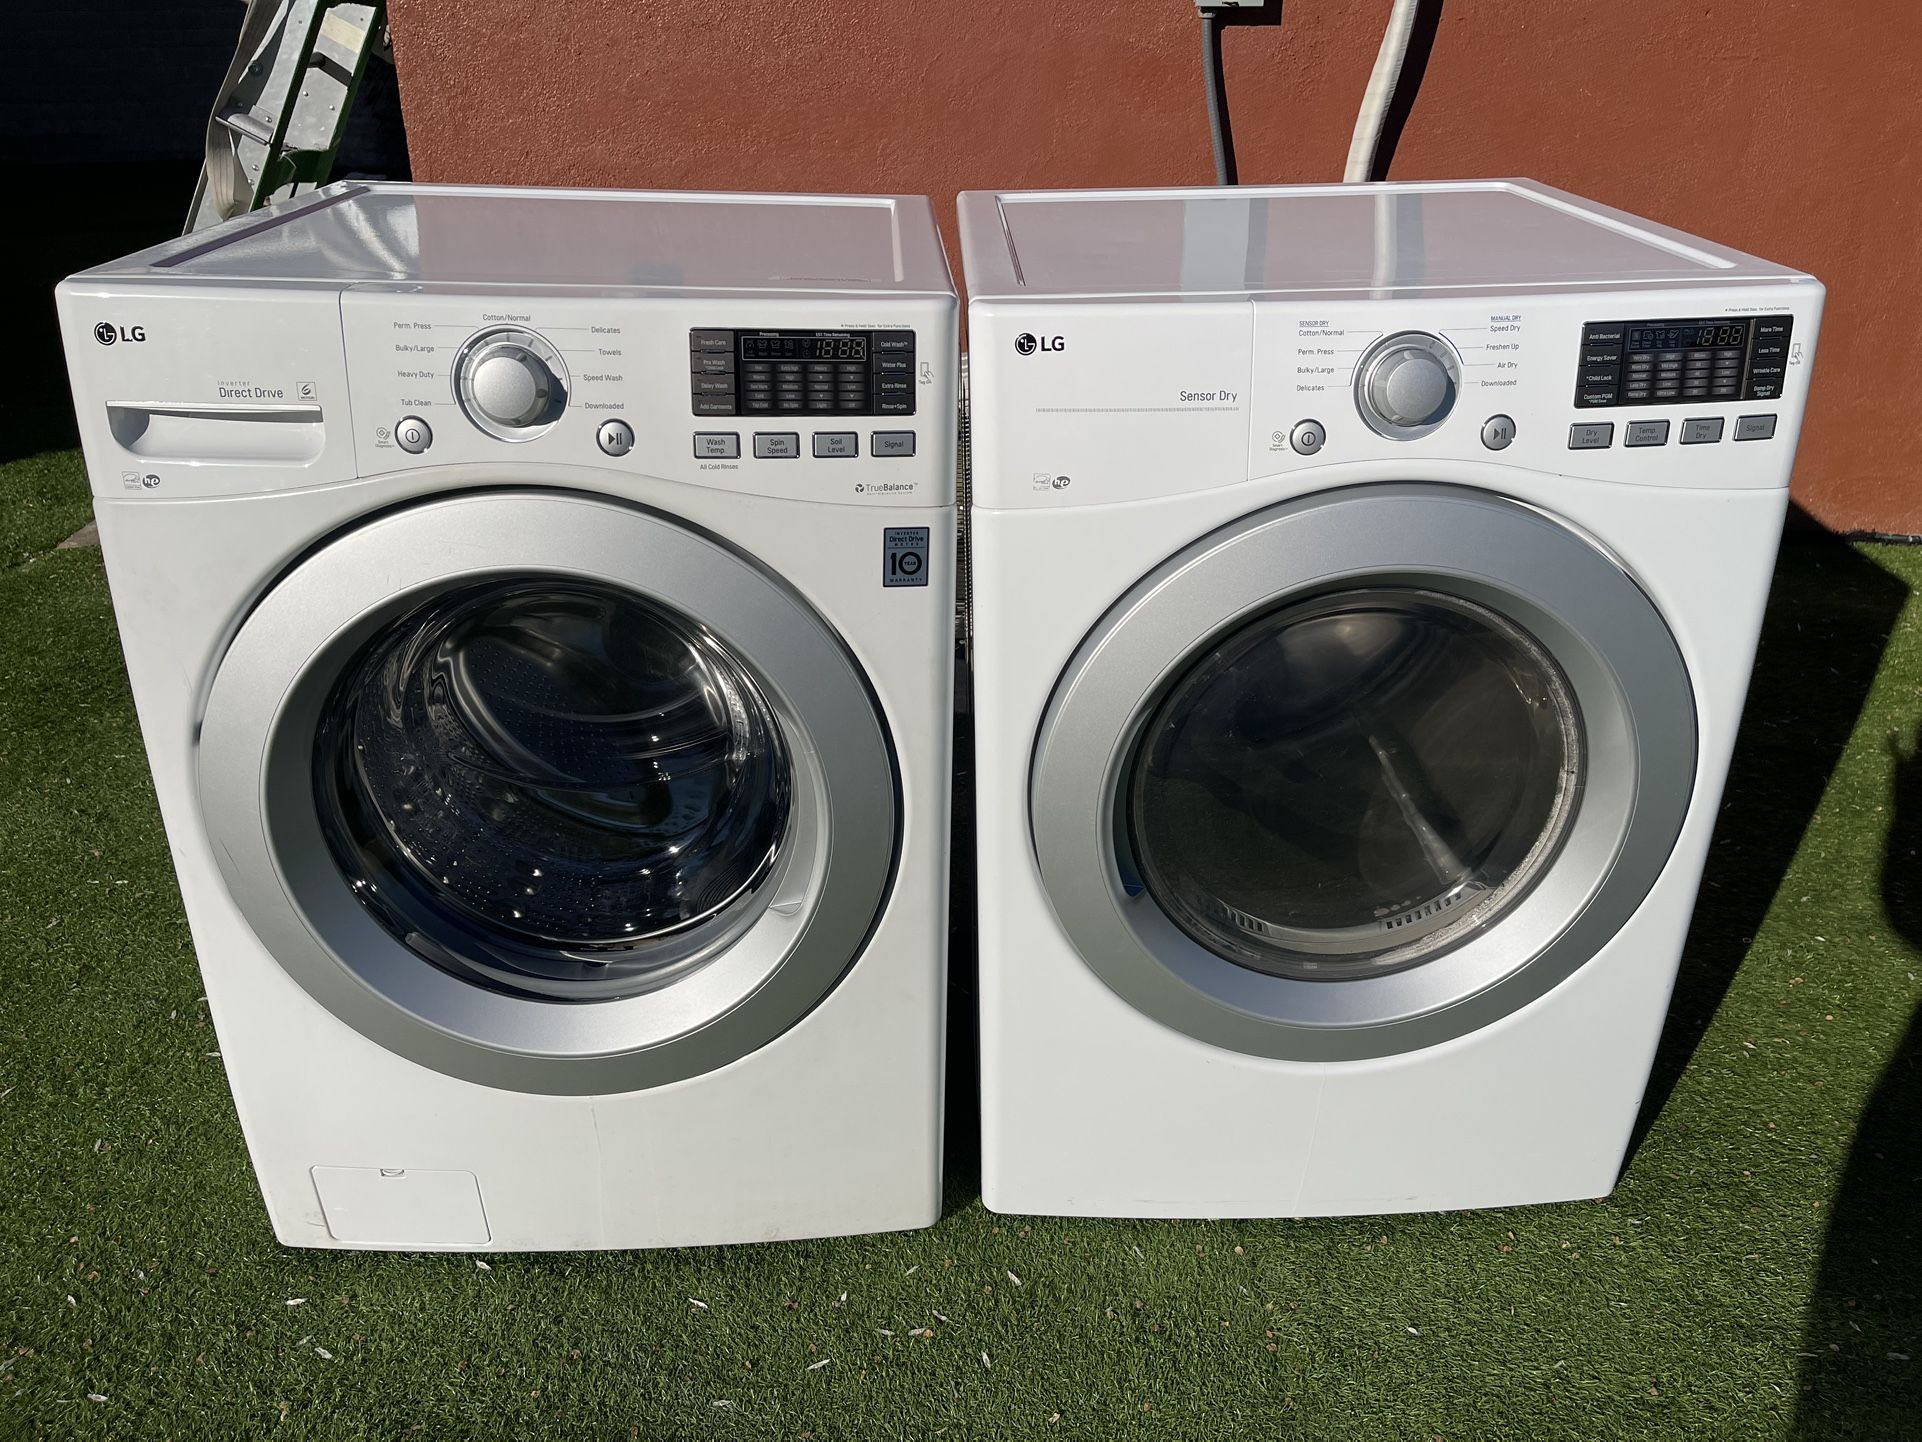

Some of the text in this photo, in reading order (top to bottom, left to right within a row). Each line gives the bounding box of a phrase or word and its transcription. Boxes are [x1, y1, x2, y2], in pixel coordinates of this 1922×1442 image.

[482, 314, 531, 322] Cotton/Normal
[393, 321, 432, 330] Perm. Press
[1489, 324, 1521, 333] Speed Dry
[120, 325, 146, 343] LG
[590, 326, 621, 335] Delicates
[1298, 329, 1344, 337] Cotton/Normal
[395, 344, 435, 353] Bulky/Large
[1040, 336, 1065, 352] LG
[1486, 343, 1520, 351] Freshen Up
[598, 348, 622, 357] Towels
[1317, 348, 1334, 356] Press
[1297, 366, 1335, 374] Bulky/Large
[1497, 361, 1518, 370] Air Dry
[397, 370, 434, 379] Heavy Duty
[583, 374, 623, 383] Speed Wash
[1481, 379, 1517, 387] Downloaded
[1296, 384, 1325, 392] Delicates
[218, 387, 284, 399] Direct Drive
[1179, 390, 1238, 403] Sensor Dry
[401, 398, 413, 406] Tub
[584, 402, 625, 410] Downloaded
[1695, 423, 1710, 431] Time
[1745, 423, 1765, 433] Signal
[1586, 429, 1598, 437] Dry
[1696, 431, 1707, 440] Dry
[706, 438, 726, 446] Wash
[830, 438, 842, 446] Soil
[1581, 436, 1600, 444] Level
[1635, 434, 1659, 442] Control
[769, 439, 785, 448] Spin
[884, 440, 904, 449] Signal
[706, 446, 725, 455] Temp
[767, 446, 788, 455] Speed
[827, 445, 846, 454] Level
[890, 551, 922, 576] 10
